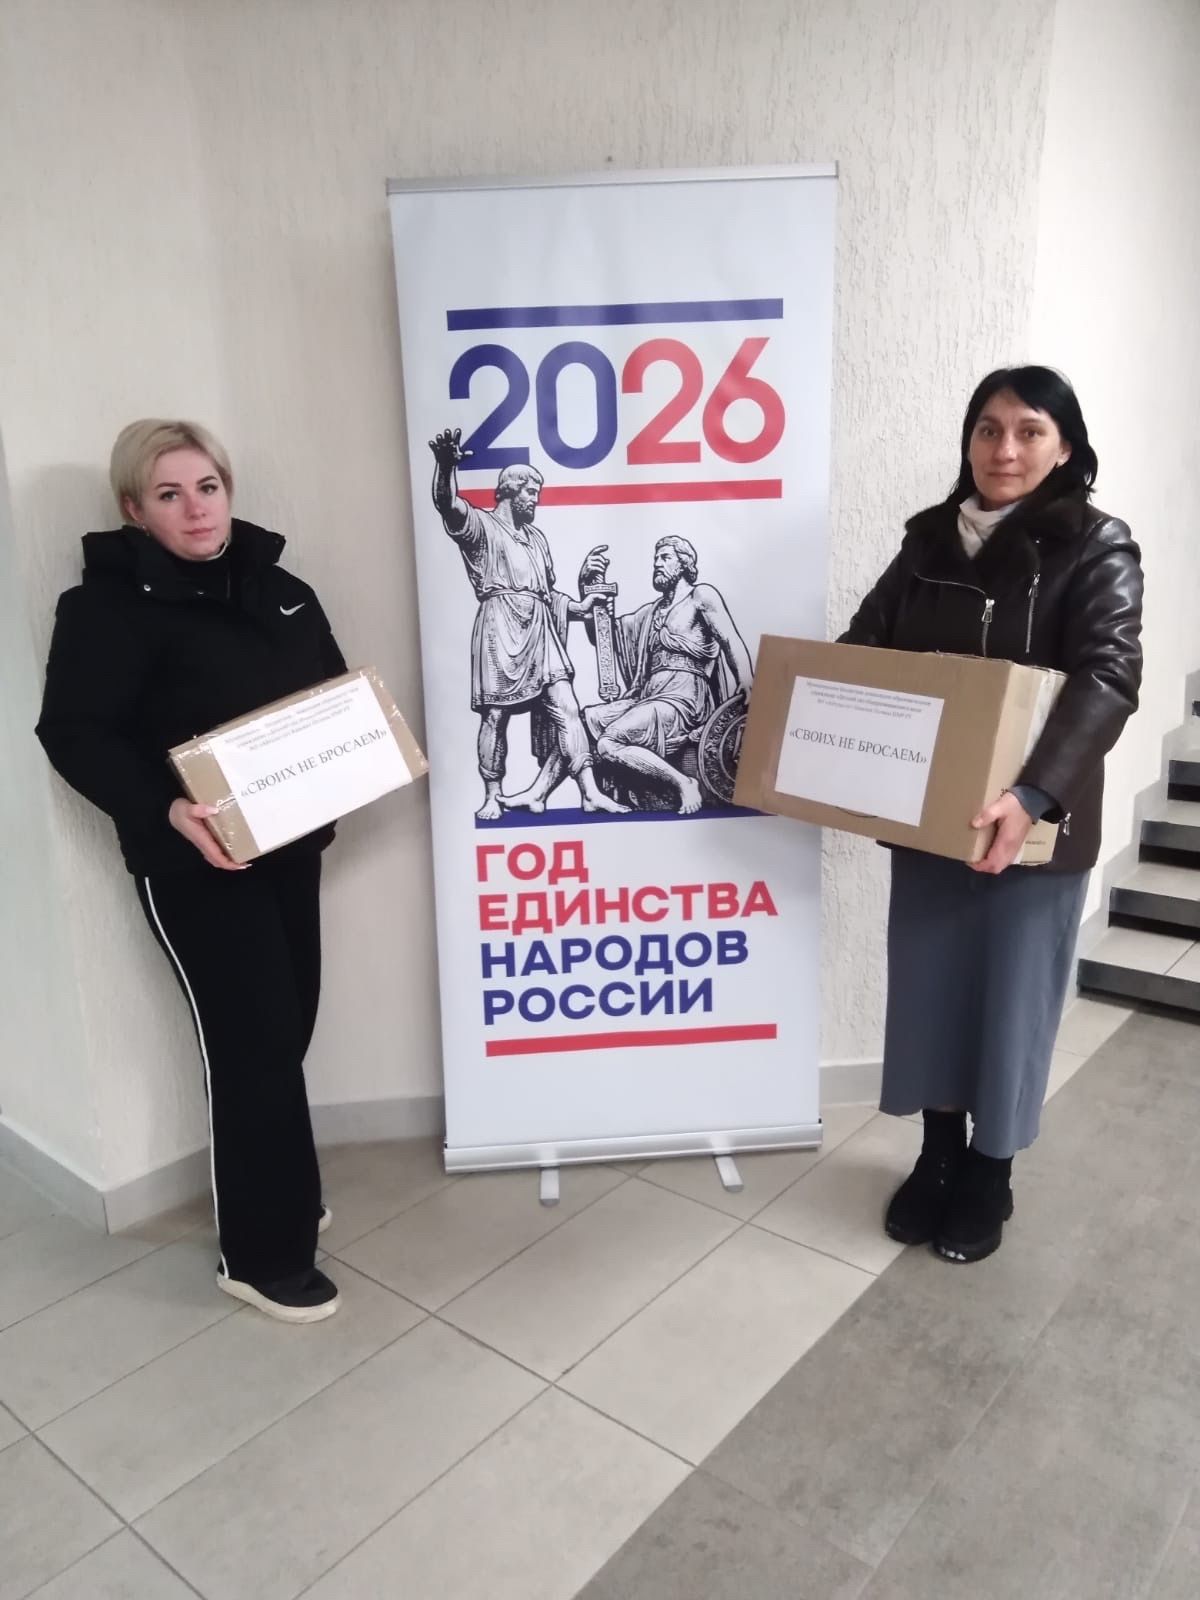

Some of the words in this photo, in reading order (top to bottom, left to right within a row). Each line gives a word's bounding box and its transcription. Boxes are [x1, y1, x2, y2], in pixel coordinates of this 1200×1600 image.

[449, 337, 785, 470] 2026
[241, 766, 296, 797] «СВОИХ
[297, 756, 319, 775] НЕ
[319, 729, 387, 765] БРОСАЕМ»
[789, 727, 835, 746] «СВОИХ
[838, 736, 856, 750] НЕ
[857, 740, 928, 764] БРОСАЕМ»
[476, 840, 589, 885] ГОД
[478, 880, 778, 936] ЕДИНСТВА
[481, 930, 749, 979] НАРОДОВ
[483, 978, 713, 1026] РОССИИ
